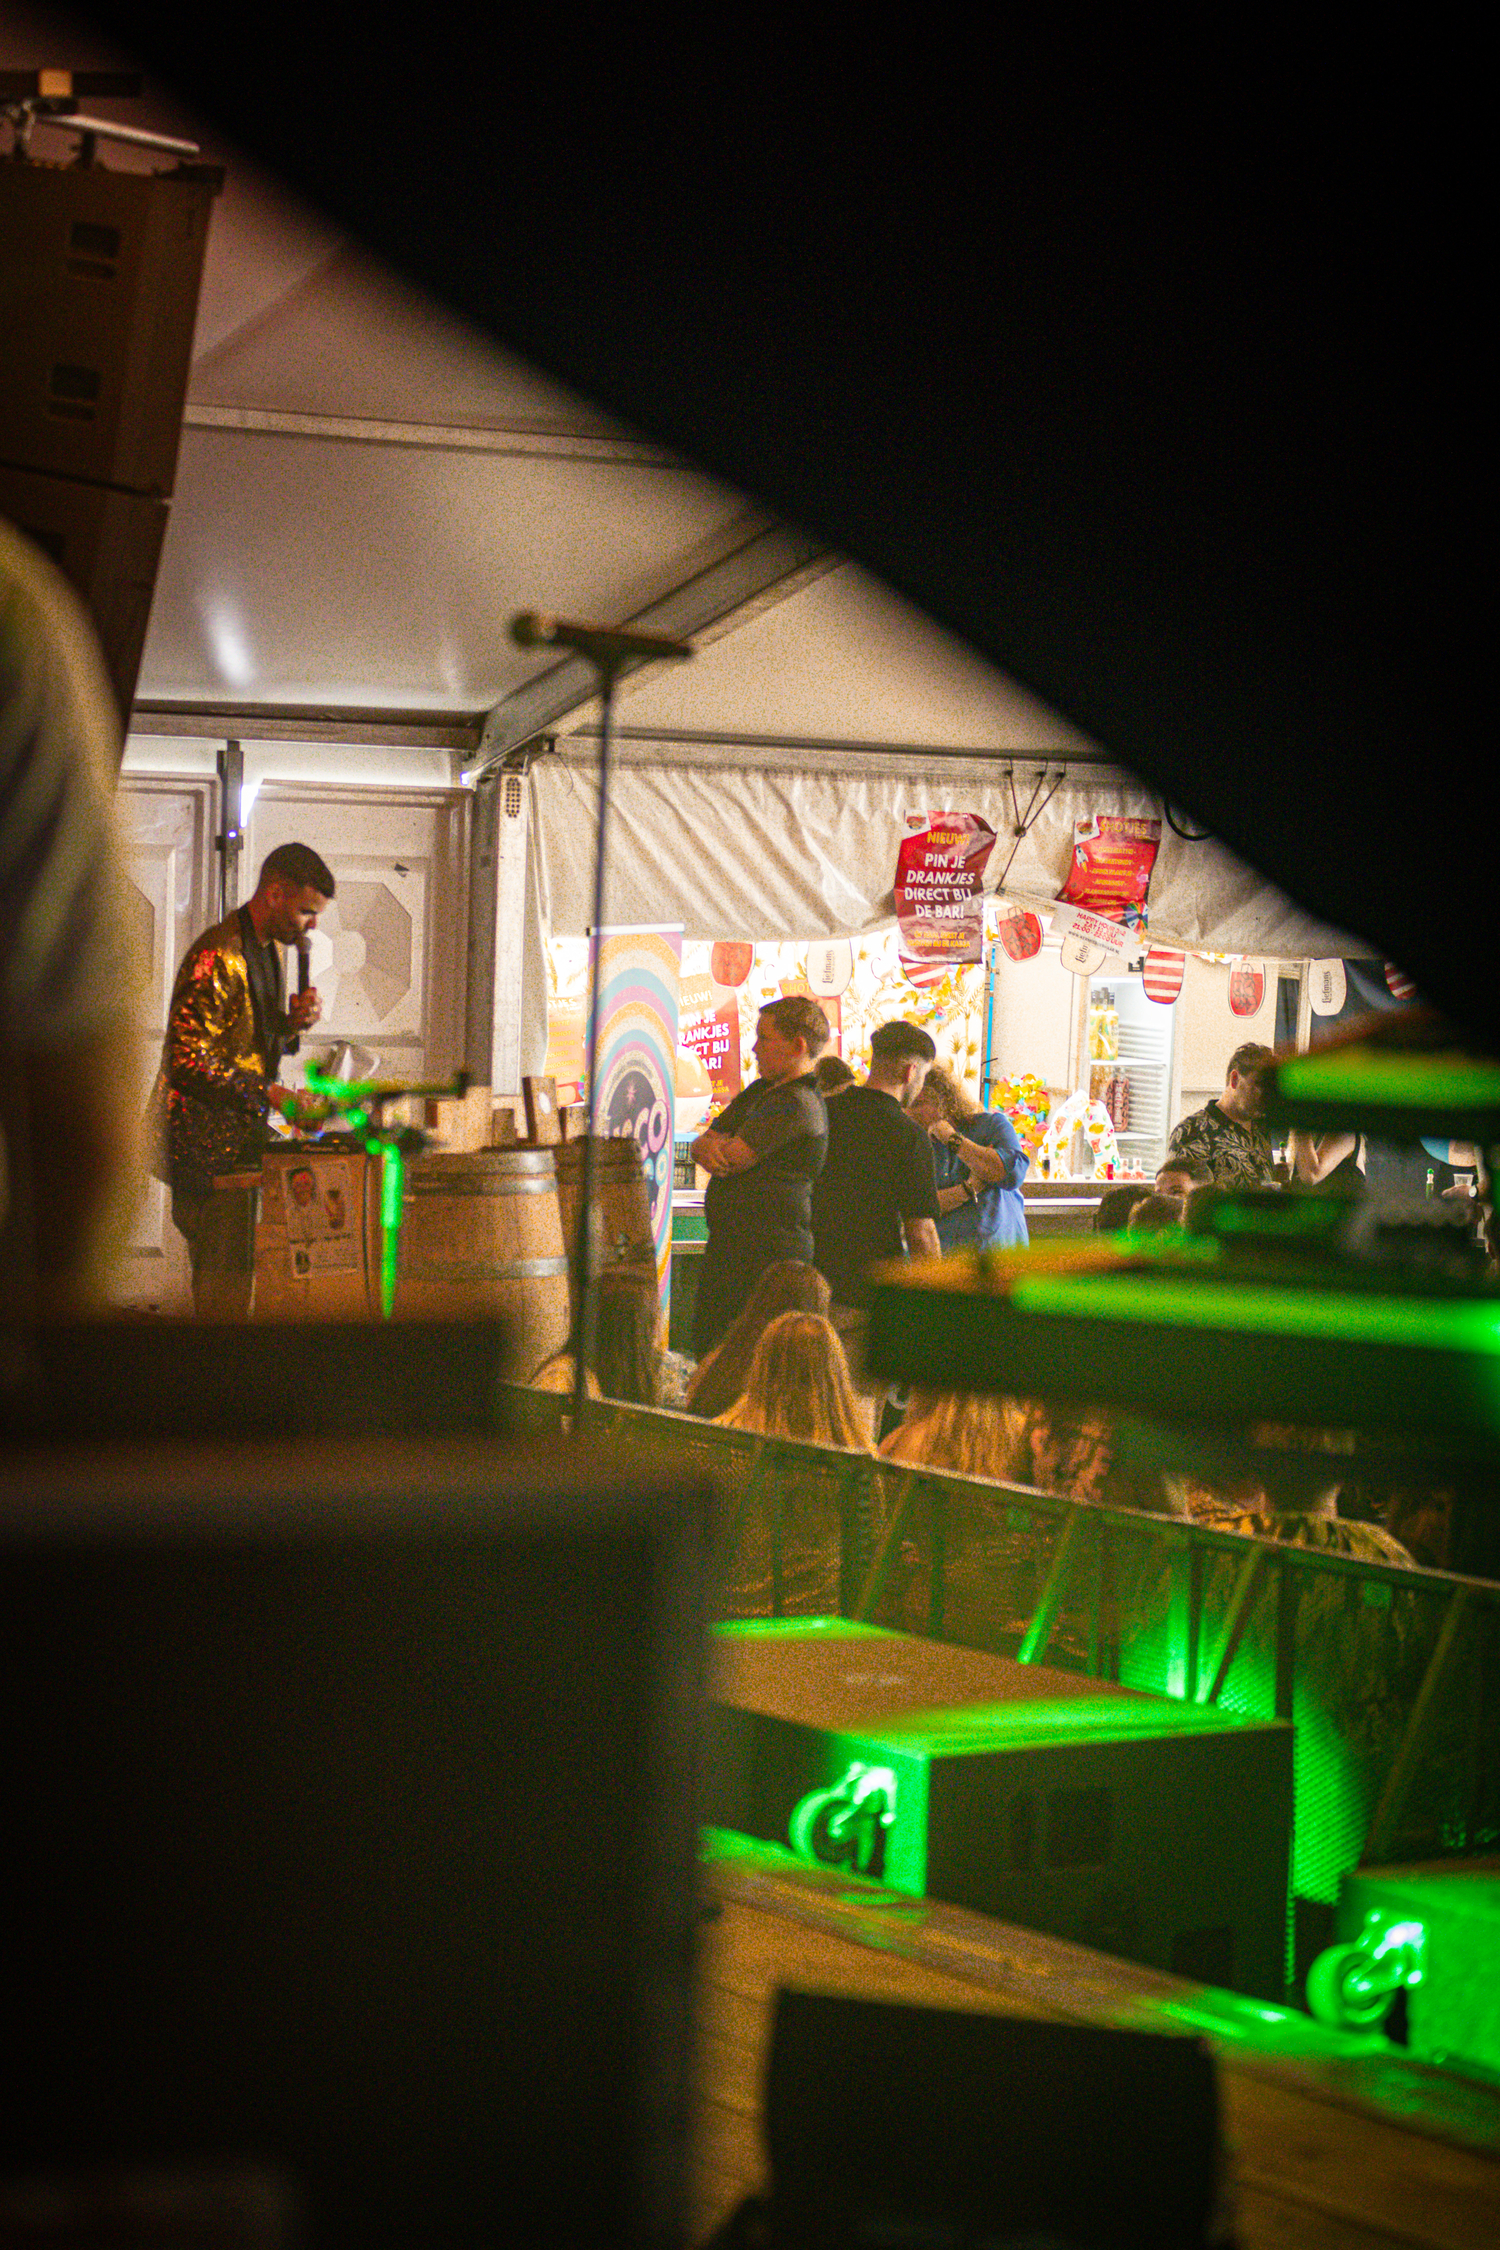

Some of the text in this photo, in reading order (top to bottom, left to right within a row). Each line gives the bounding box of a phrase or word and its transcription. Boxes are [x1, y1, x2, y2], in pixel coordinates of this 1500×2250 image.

[926, 832, 970, 845] NIEUW!
[924, 853, 966, 869] PIN JE
[906, 870, 976, 885] DRANKJES
[904, 887, 972, 901] DIRECT BIJ
[914, 905, 965, 919] DE BAR!
[1077, 912, 1099, 925] HAPPY
[1099, 920, 1116, 933] HOUR
[1083, 921, 1097, 930] ZAT
[1072, 922, 1091, 934] 21:00
[1110, 938, 1125, 948] UUR
[950, 940, 971, 948] KASSA
[822, 949, 834, 984] Liefmans
[781, 981, 812, 994] SHOT
[1321, 971, 1332, 1004] Liefmans
[680, 990, 713, 1007] IEUW!
[677, 1008, 716, 1029] PIN JE
[677, 1022, 730, 1046] RANKJES
[712, 1039, 730, 1054] BIJ
[702, 1056, 723, 1070] AR!
[713, 1086, 730, 1094] ASSA
